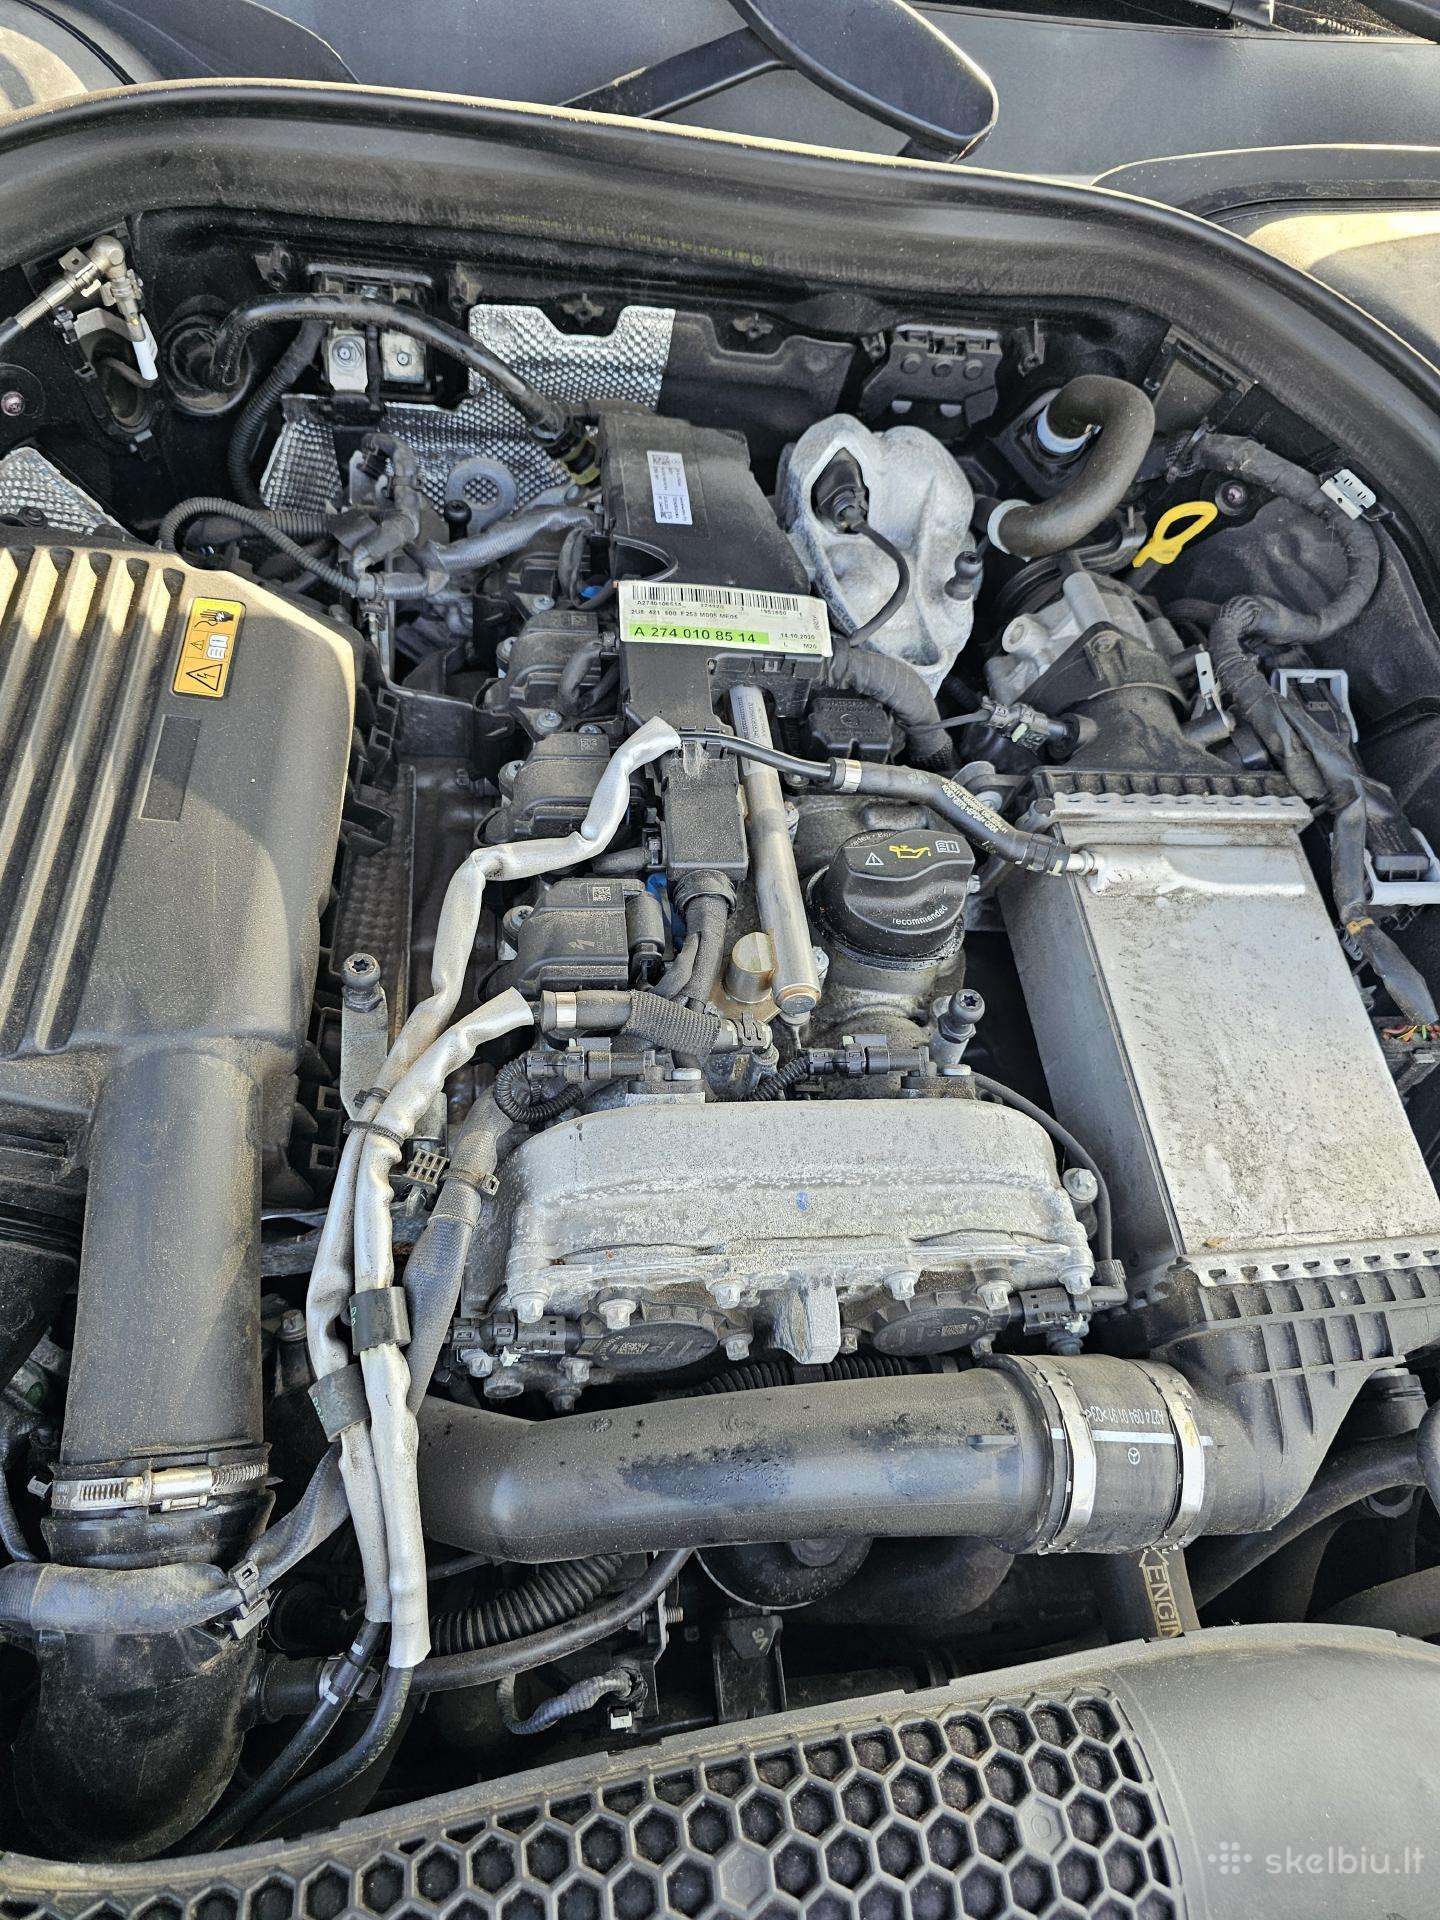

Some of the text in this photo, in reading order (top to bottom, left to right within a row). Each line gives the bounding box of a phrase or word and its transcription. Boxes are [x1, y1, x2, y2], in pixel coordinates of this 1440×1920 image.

[634, 626, 756, 643] A 274 010 85 14
[892, 904, 948, 926] recommended
